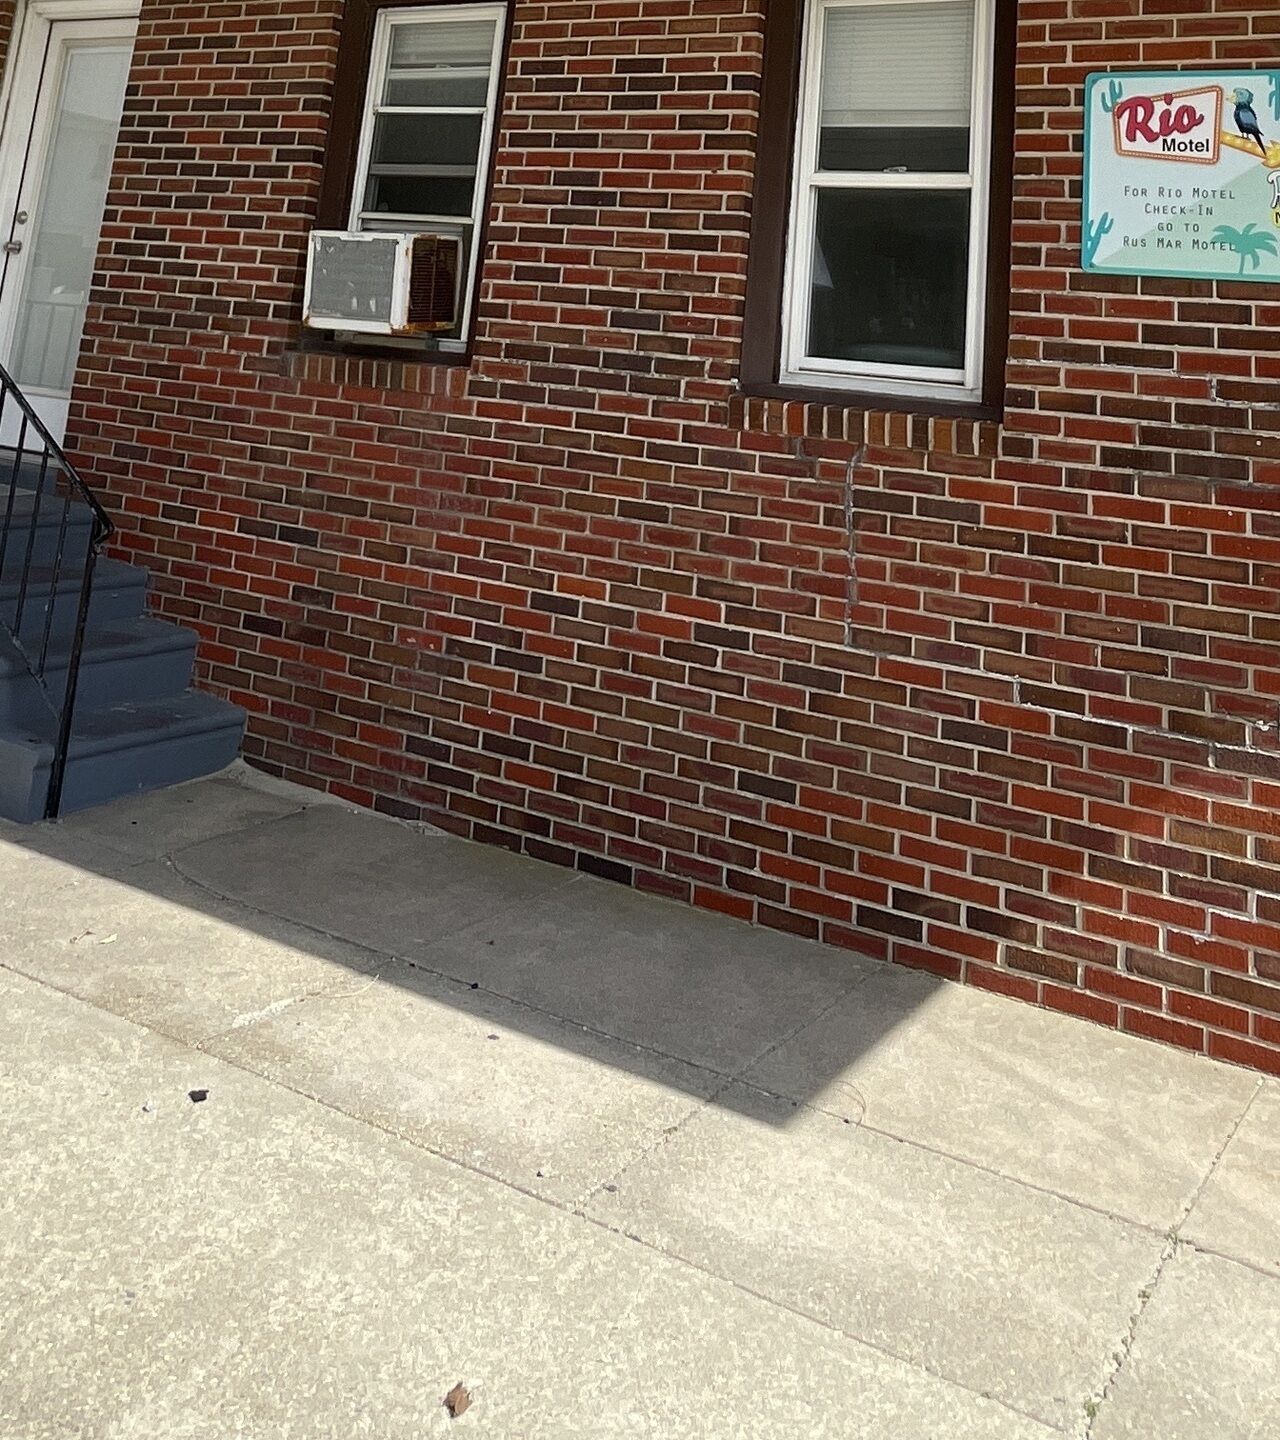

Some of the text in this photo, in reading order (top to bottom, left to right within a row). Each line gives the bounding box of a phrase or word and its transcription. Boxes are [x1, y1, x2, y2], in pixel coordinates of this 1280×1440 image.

[1116, 93, 1205, 143] Rio
[1162, 138, 1209, 152] Motel
[1157, 222, 1200, 233] GO TO
